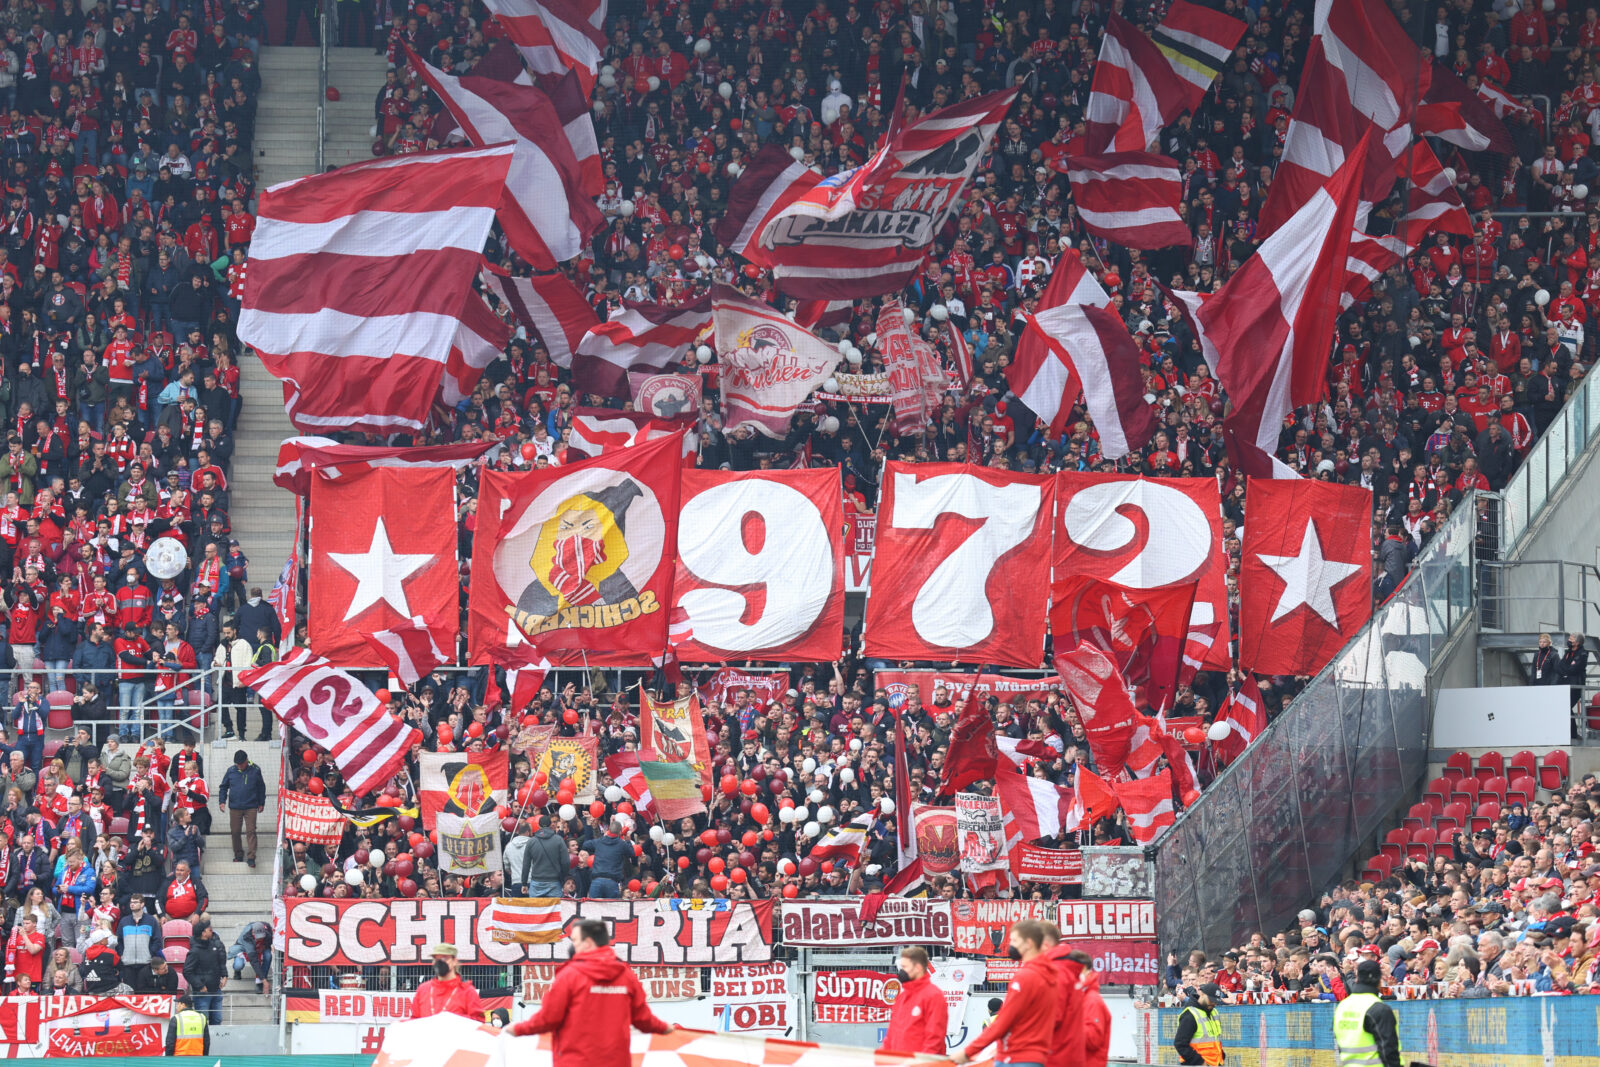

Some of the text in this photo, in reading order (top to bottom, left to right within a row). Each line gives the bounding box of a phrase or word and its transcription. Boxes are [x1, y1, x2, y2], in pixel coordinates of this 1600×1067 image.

[446, 836, 489, 855] ULTRAS
[1060, 904, 1155, 935] COLEGIO
[288, 899, 772, 964] SCHICERIA
[956, 926, 986, 949] RED
[650, 980, 696, 998] UNS
[713, 979, 786, 996] BEI DIR
[325, 995, 413, 1018] RED MUN
[815, 1003, 869, 1023] LETZTE
